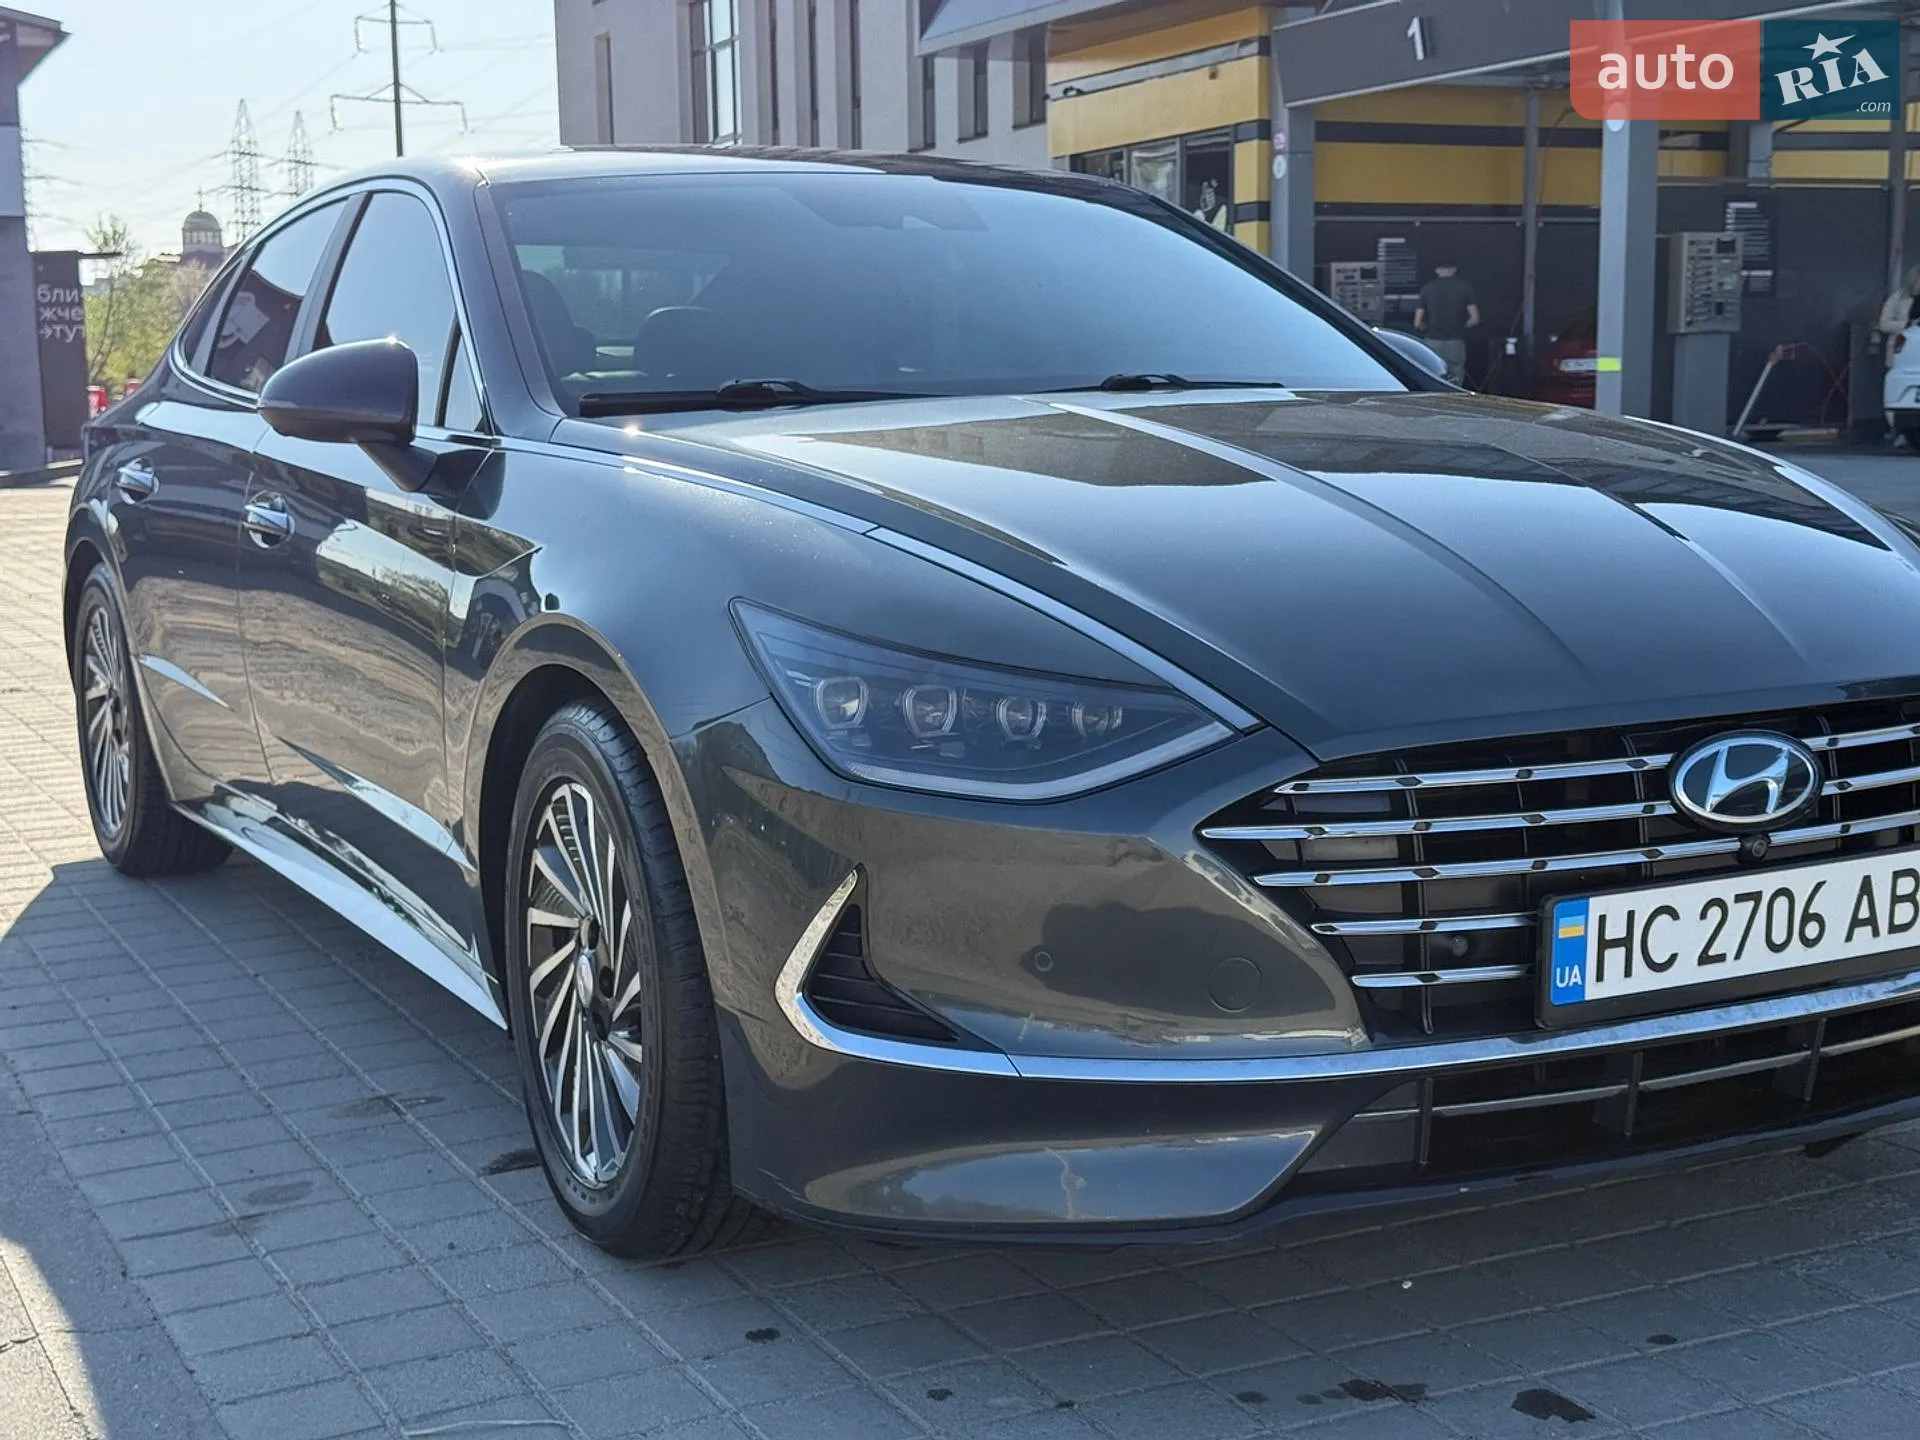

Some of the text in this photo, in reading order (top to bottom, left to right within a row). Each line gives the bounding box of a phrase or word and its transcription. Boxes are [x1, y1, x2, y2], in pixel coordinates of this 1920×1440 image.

[1407, 17, 1425, 61] 1
[39, 306, 84, 321] жче
[1596, 867, 1920, 983] HC 2706 AB
[1556, 964, 1583, 988] UA
